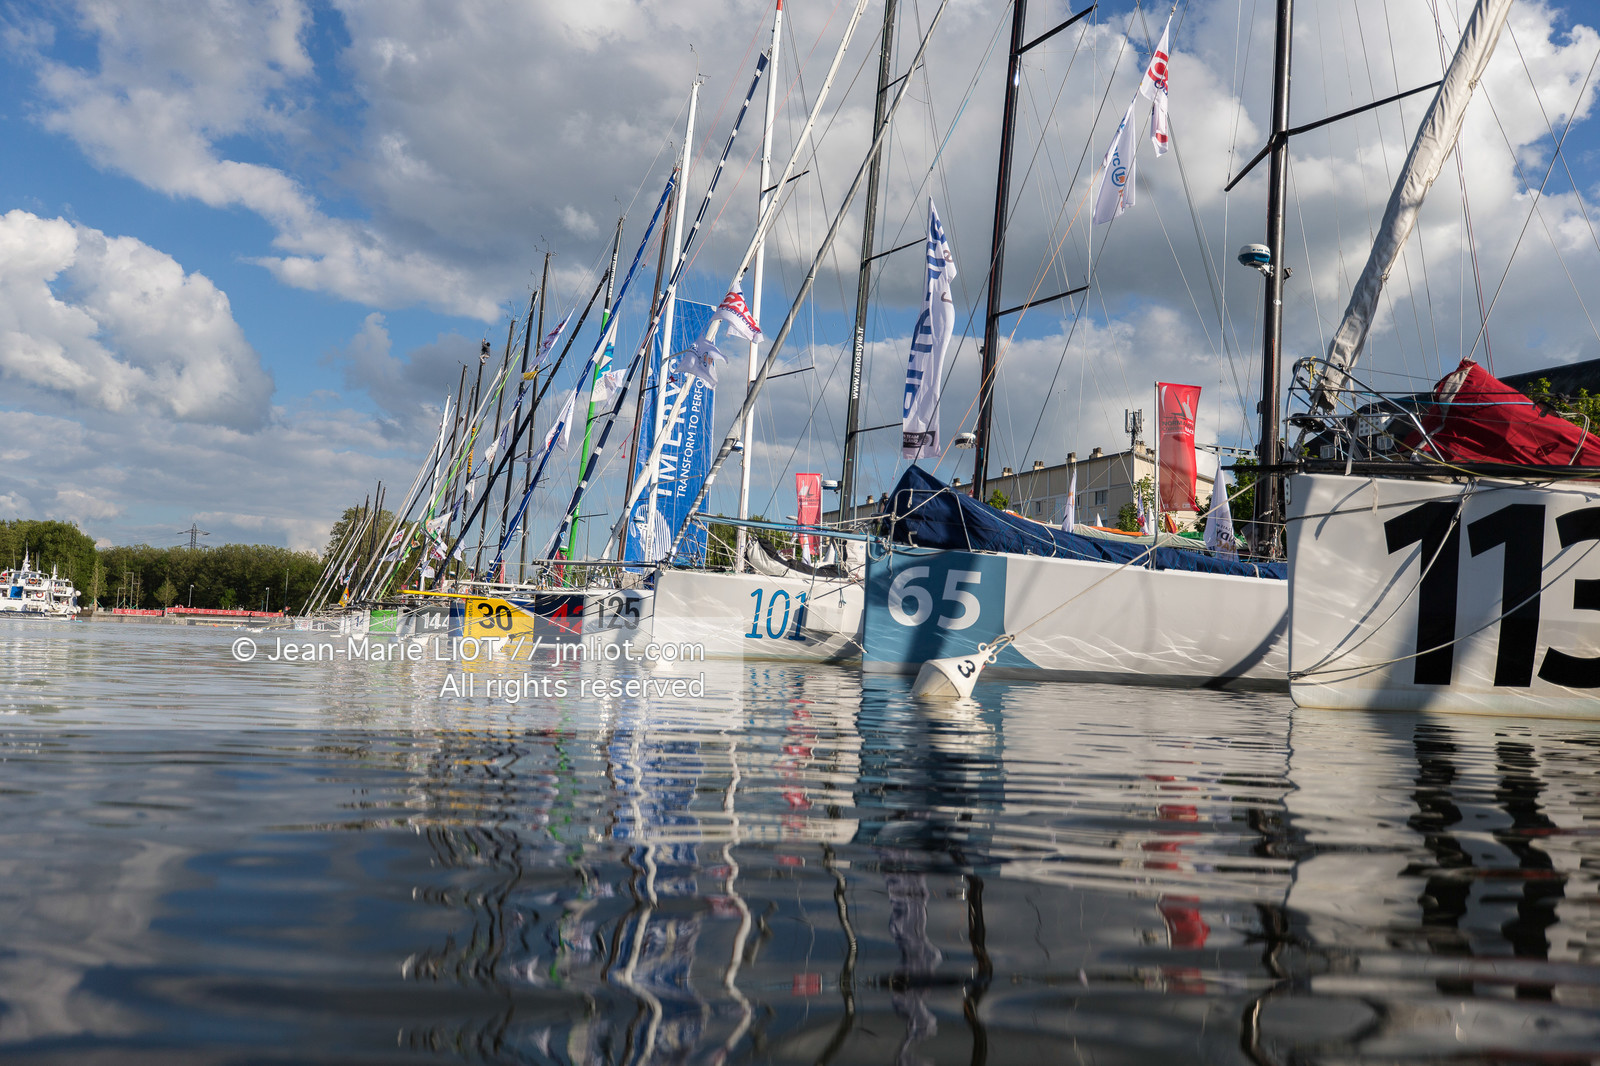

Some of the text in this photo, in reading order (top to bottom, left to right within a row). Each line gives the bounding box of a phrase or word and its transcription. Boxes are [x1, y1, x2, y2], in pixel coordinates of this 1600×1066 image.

[852, 327, 864, 400] www.renostyle.fr
[691, 376, 705, 412] PERFO
[689, 414, 699, 431] TO
[677, 431, 697, 498] TRANSFORM
[595, 597, 639, 629] 125
[887, 566, 981, 630] 65
[1384, 502, 1600, 688] 113
[477, 602, 512, 632] 30
[548, 603, 584, 635] 42
[745, 588, 806, 641] 101
[958, 659, 976, 679] 3
